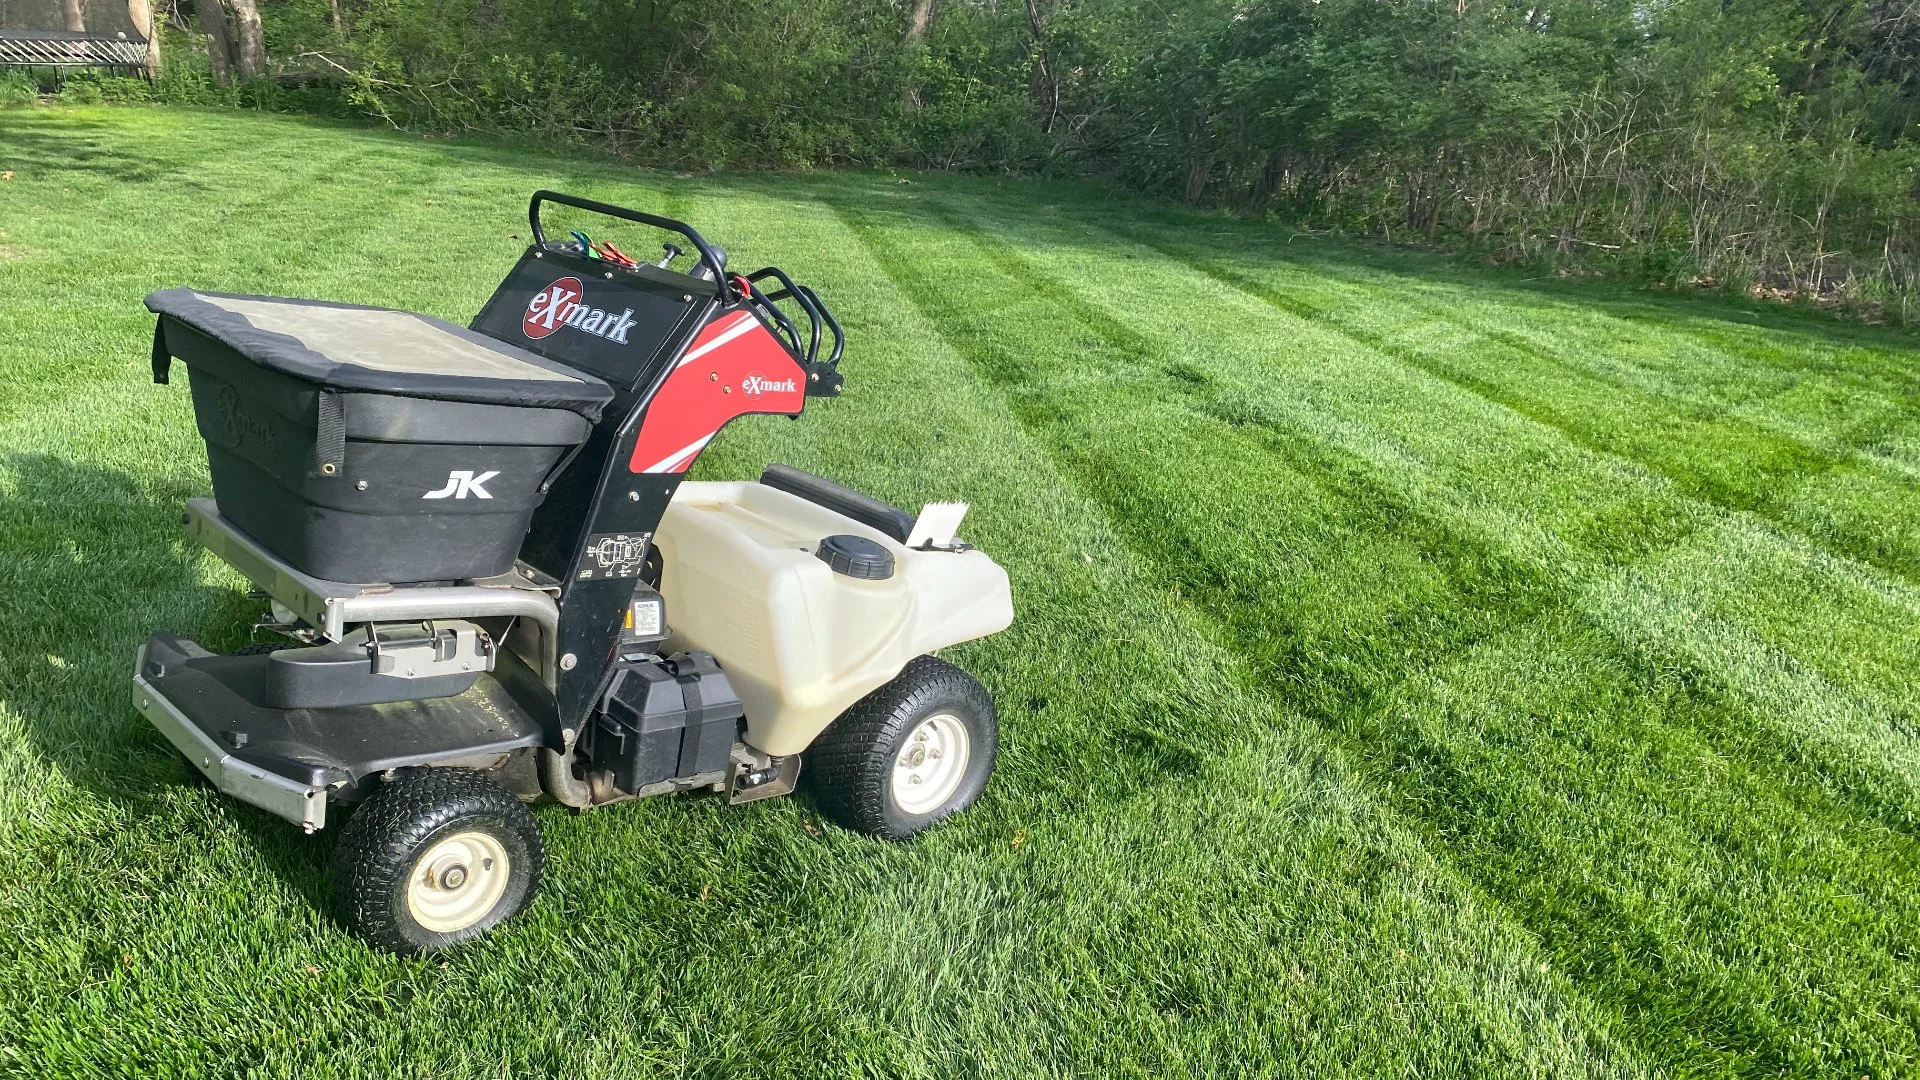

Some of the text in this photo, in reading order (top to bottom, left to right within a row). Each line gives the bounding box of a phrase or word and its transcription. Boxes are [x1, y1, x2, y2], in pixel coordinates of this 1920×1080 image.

[528, 285, 638, 345] eXmark
[742, 375, 796, 395] eXmark
[421, 470, 501, 499] JK
